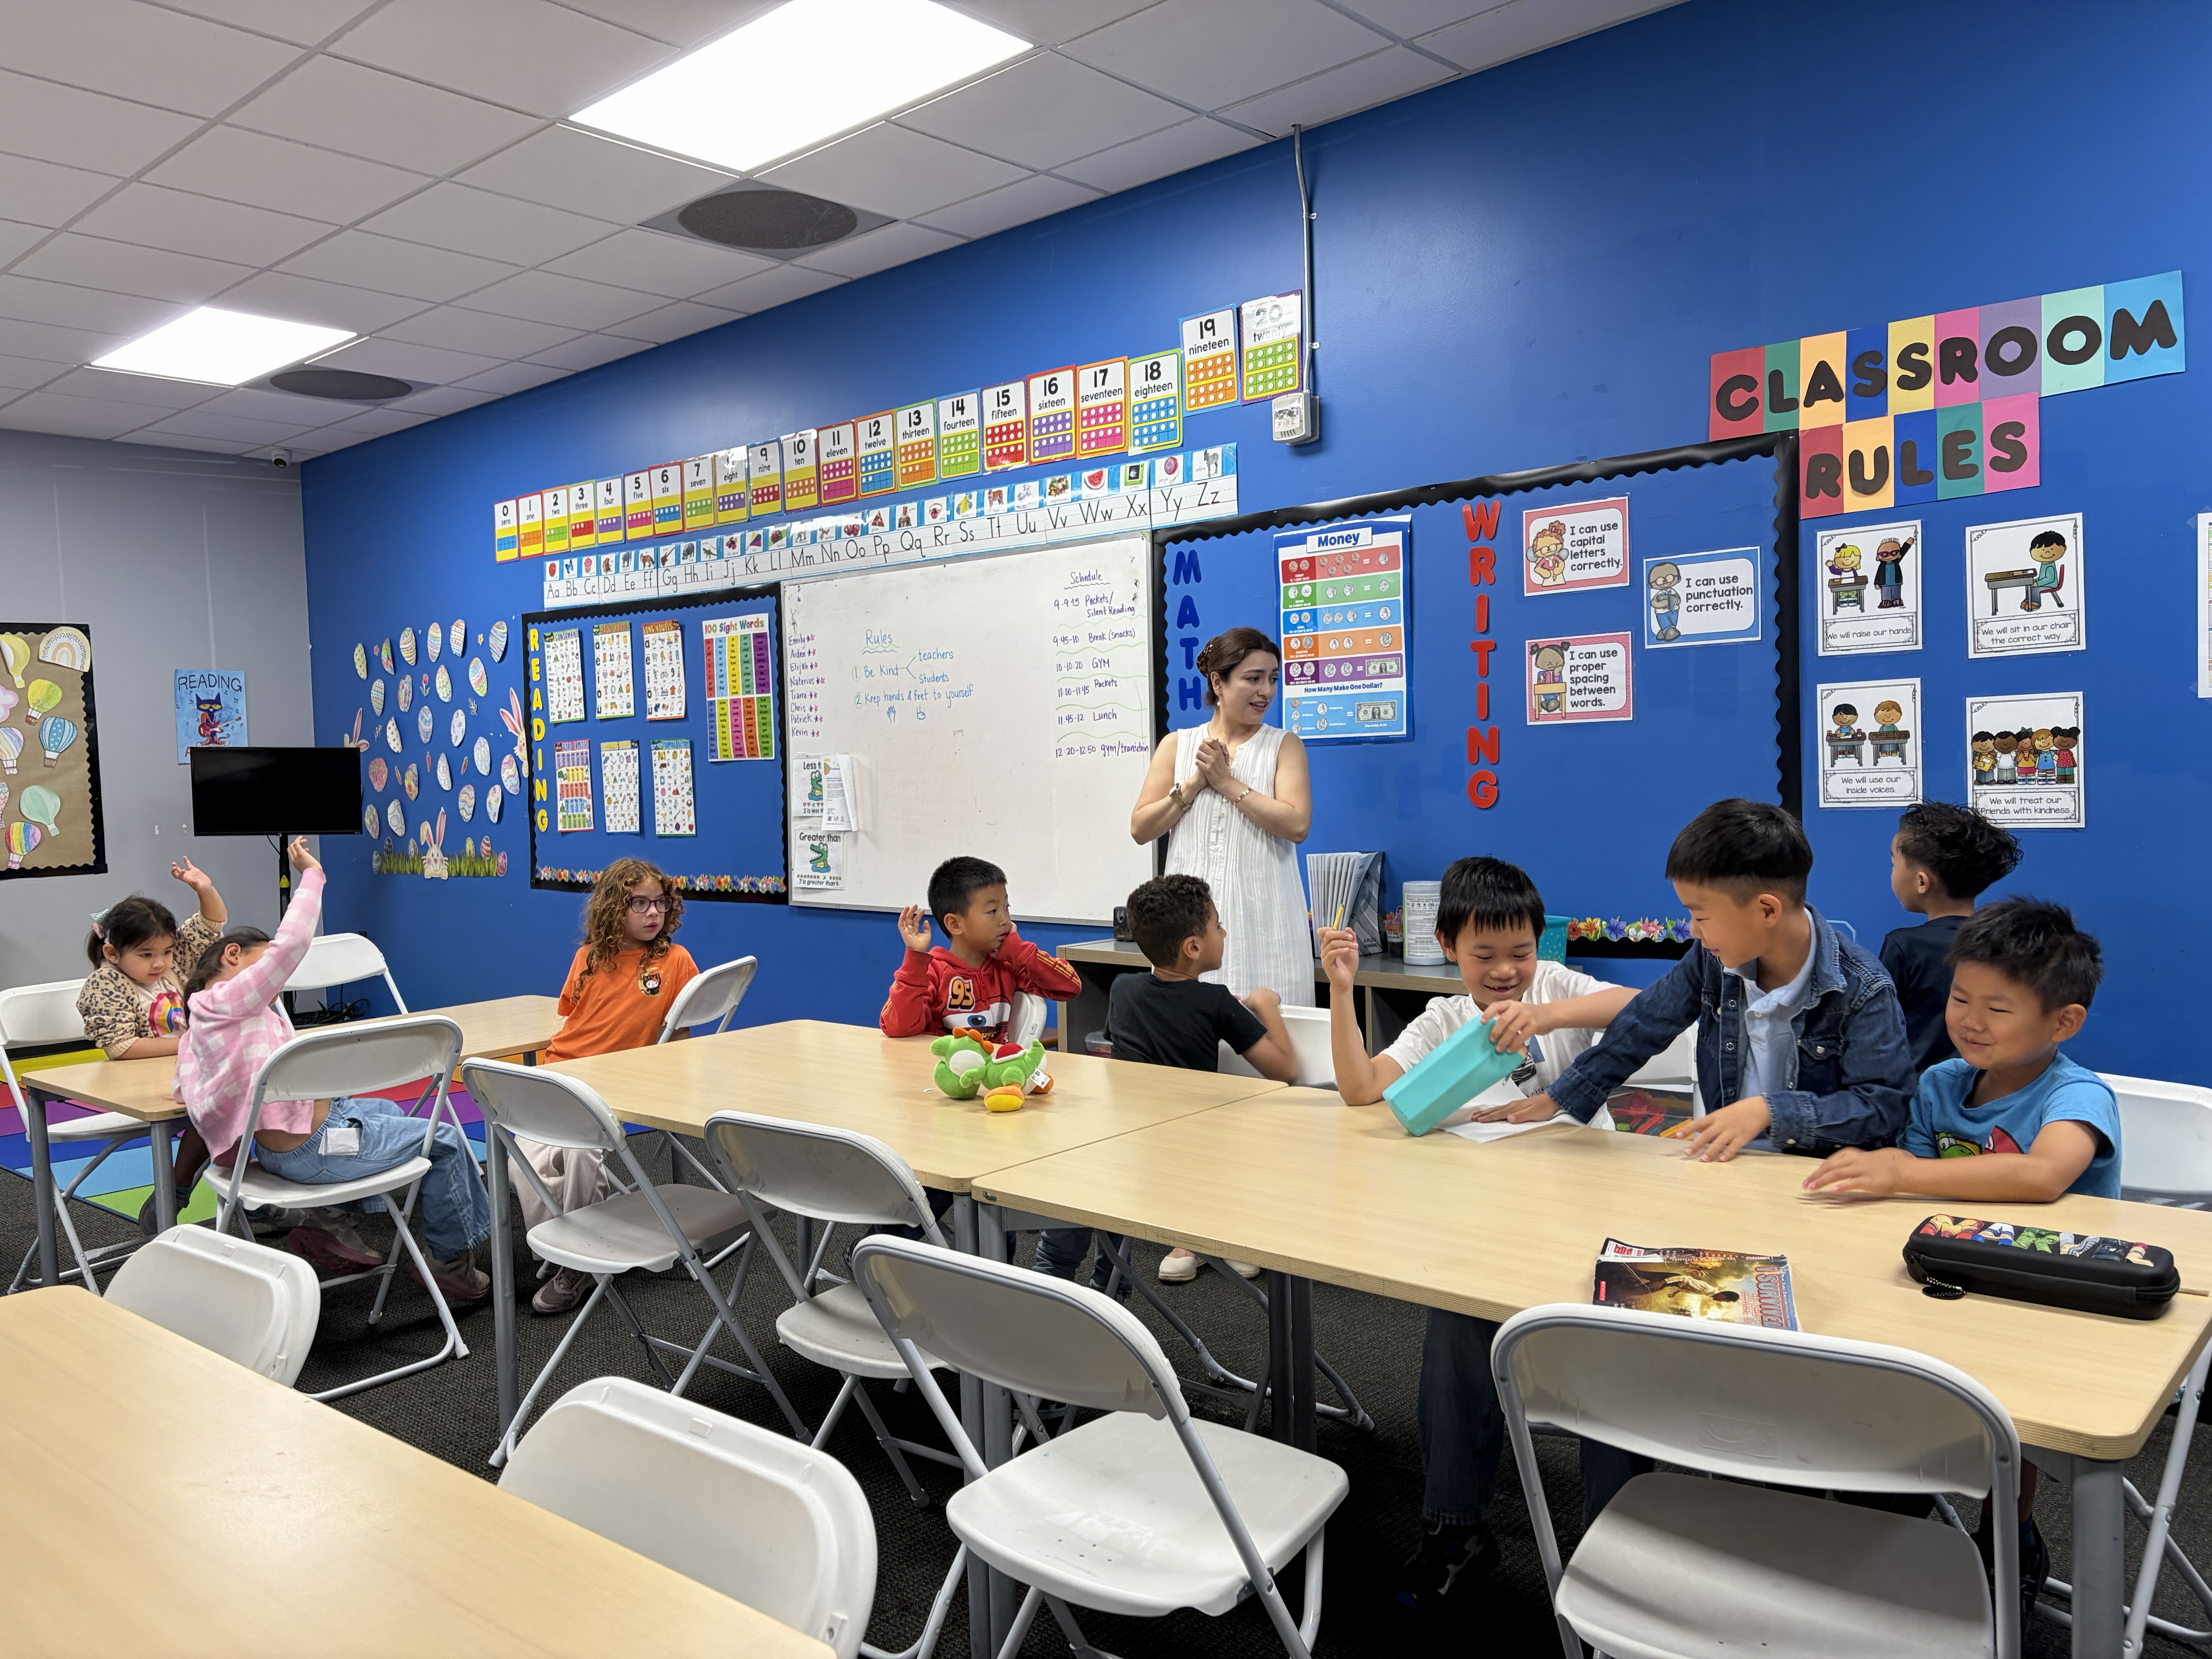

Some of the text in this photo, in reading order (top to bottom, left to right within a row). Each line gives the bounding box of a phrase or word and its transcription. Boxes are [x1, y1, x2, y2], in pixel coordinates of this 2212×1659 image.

[1200, 318, 1216, 339] 19
[1188, 337, 1230, 356] nineteen
[1716, 300, 2178, 421] CLASSROOM
[1094, 368, 1108, 388] 17
[1145, 361, 1161, 381] 18
[1044, 377, 1058, 396] 16
[1134, 381, 1173, 398] eighteen
[996, 389, 1010, 407] 15
[1080, 387, 1123, 403] seventeen
[1038, 397, 1065, 410] sixteen
[991, 407, 1017, 421] fifteen
[943, 417, 975, 431] fourteen
[1278, 418, 1296, 426] FIRE
[902, 426, 930, 439] thirteen
[864, 437, 886, 450] twelve
[826, 447, 848, 458] eleven
[794, 457, 805, 466] ten
[1805, 421, 2028, 500] RULES
[758, 464, 771, 473] nine
[690, 478, 706, 487] seven
[724, 471, 737, 483] eight
[633, 491, 644, 499] five
[661, 485, 670, 493] six
[574, 501, 589, 509] three
[604, 497, 615, 505] four
[1570, 522, 1618, 535] I can use
[547, 482, 1220, 598] Aa Bb Cc Dd Ee Ff Gg Mm Nn Oo Pp Qq Rr Ss Vv Ww Yy Zz
[1317, 532, 1360, 548] Money
[1570, 534, 1606, 548] capital
[1570, 547, 1606, 560] letters
[1570, 558, 1623, 572] correctly.
[1070, 569, 1103, 584] Schedule
[1686, 574, 1739, 587] I can use
[1686, 586, 1753, 602] punctuation
[1087, 604, 1135, 617] Silent Reading
[1686, 599, 1743, 613] correctly.
[705, 618, 764, 634] 100 Sight Words
[1173, 549, 1201, 711] MATH
[788, 635, 805, 649] Emily
[866, 629, 892, 645] Rules
[1053, 629, 1135, 647] 9:45-10 Break (snacks)
[2008, 634, 2041, 642] correct
[790, 650, 806, 659] Aiden
[919, 647, 954, 659] teachers
[1462, 500, 1501, 809] WRITING
[1569, 648, 1618, 661] I can use
[790, 662, 809, 674] Elijah
[864, 664, 898, 678] Be Kind
[1056, 658, 1110, 672] 10-10:20 GYM
[1570, 661, 1607, 674] proper
[178, 674, 242, 692] READING
[1094, 679, 1118, 688] Packets
[1570, 673, 1609, 685] spacing
[790, 690, 807, 699] Tiana
[865, 685, 974, 708] Keep hands & feet to yourself
[1570, 685, 1616, 696] between
[790, 703, 806, 712] Chris
[1570, 697, 1606, 708] words.
[790, 714, 812, 724] Patrick
[1058, 709, 1117, 725] 11:45-12 Lunch
[529, 628, 548, 832] READING
[792, 727, 808, 737] Kevin
[799, 833, 841, 842] Greater than
[948, 978, 975, 1010] 95
[1920, 1214, 2154, 1267] MARVEL
[1756, 1274, 1783, 1328] SURVIVED
